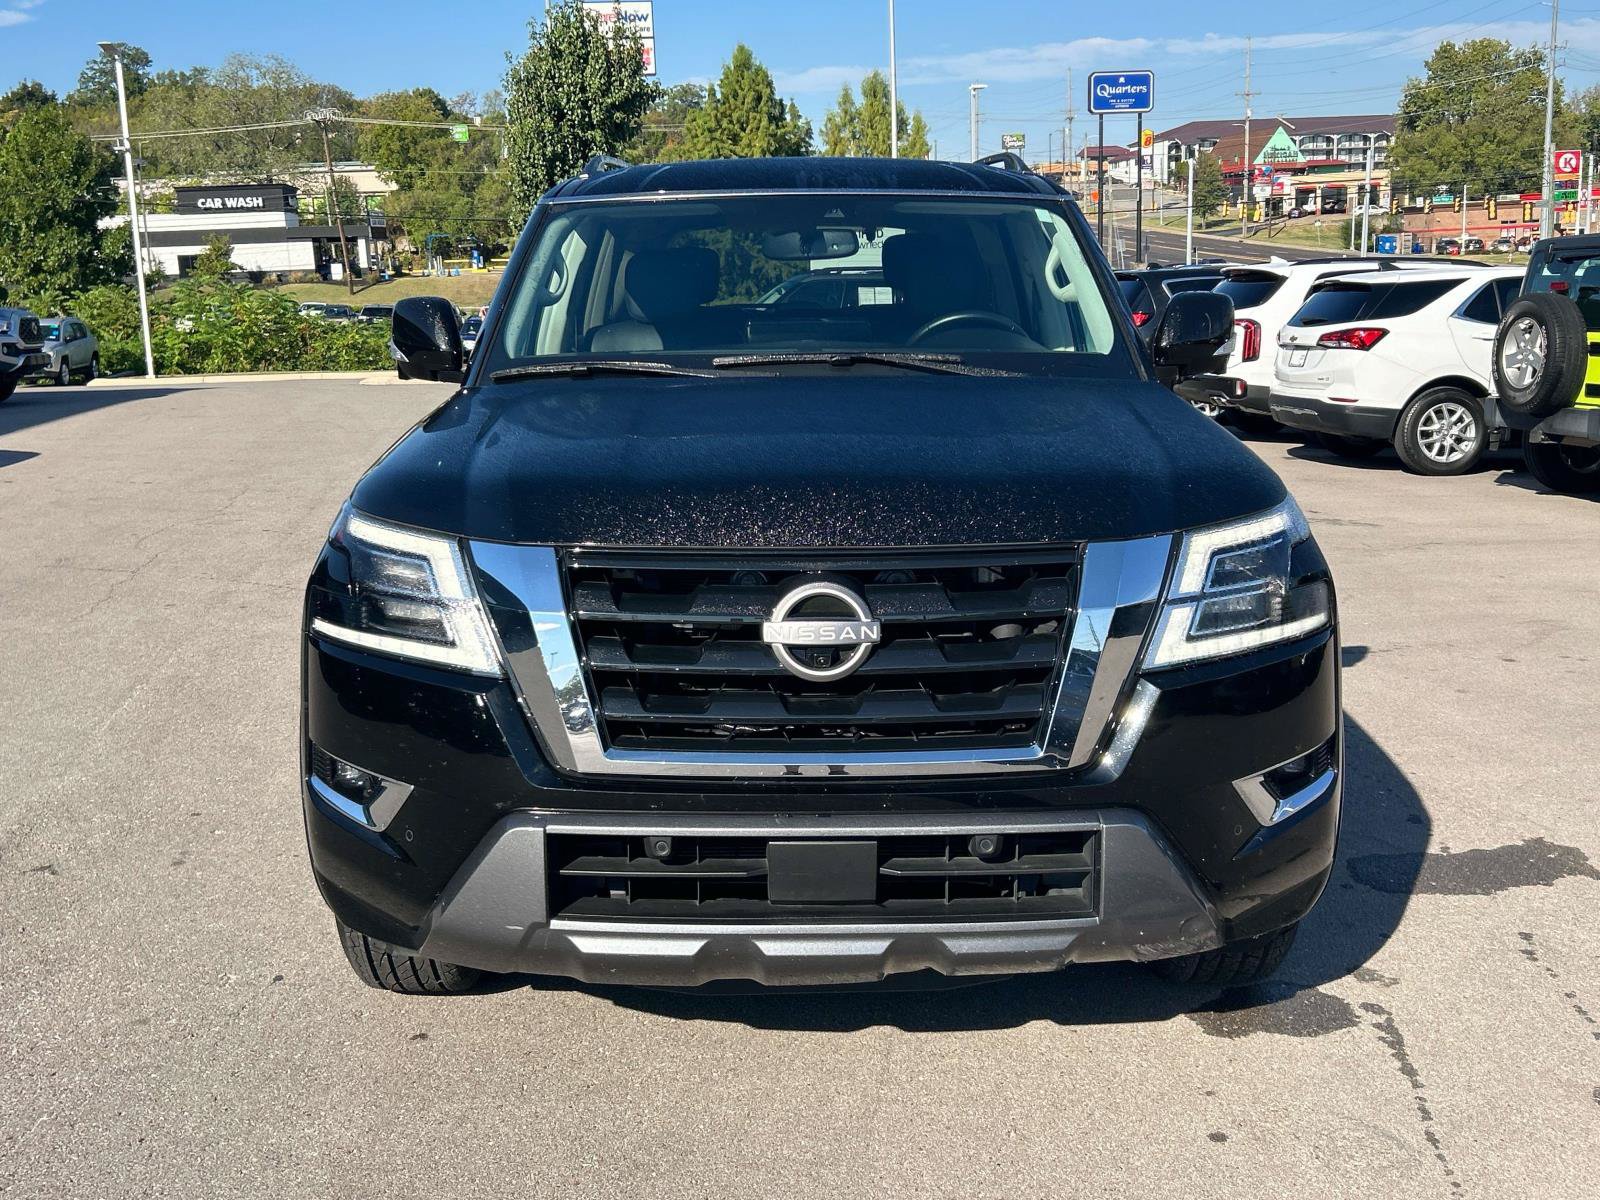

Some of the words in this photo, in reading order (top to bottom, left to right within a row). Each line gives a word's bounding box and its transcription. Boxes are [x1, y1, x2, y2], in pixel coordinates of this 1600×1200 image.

[1097, 83, 1148, 97] Quarters
[1562, 157, 1574, 169] K
[197, 198, 222, 209] CAR
[225, 196, 263, 208] WASH
[766, 625, 878, 640] NISSAN
